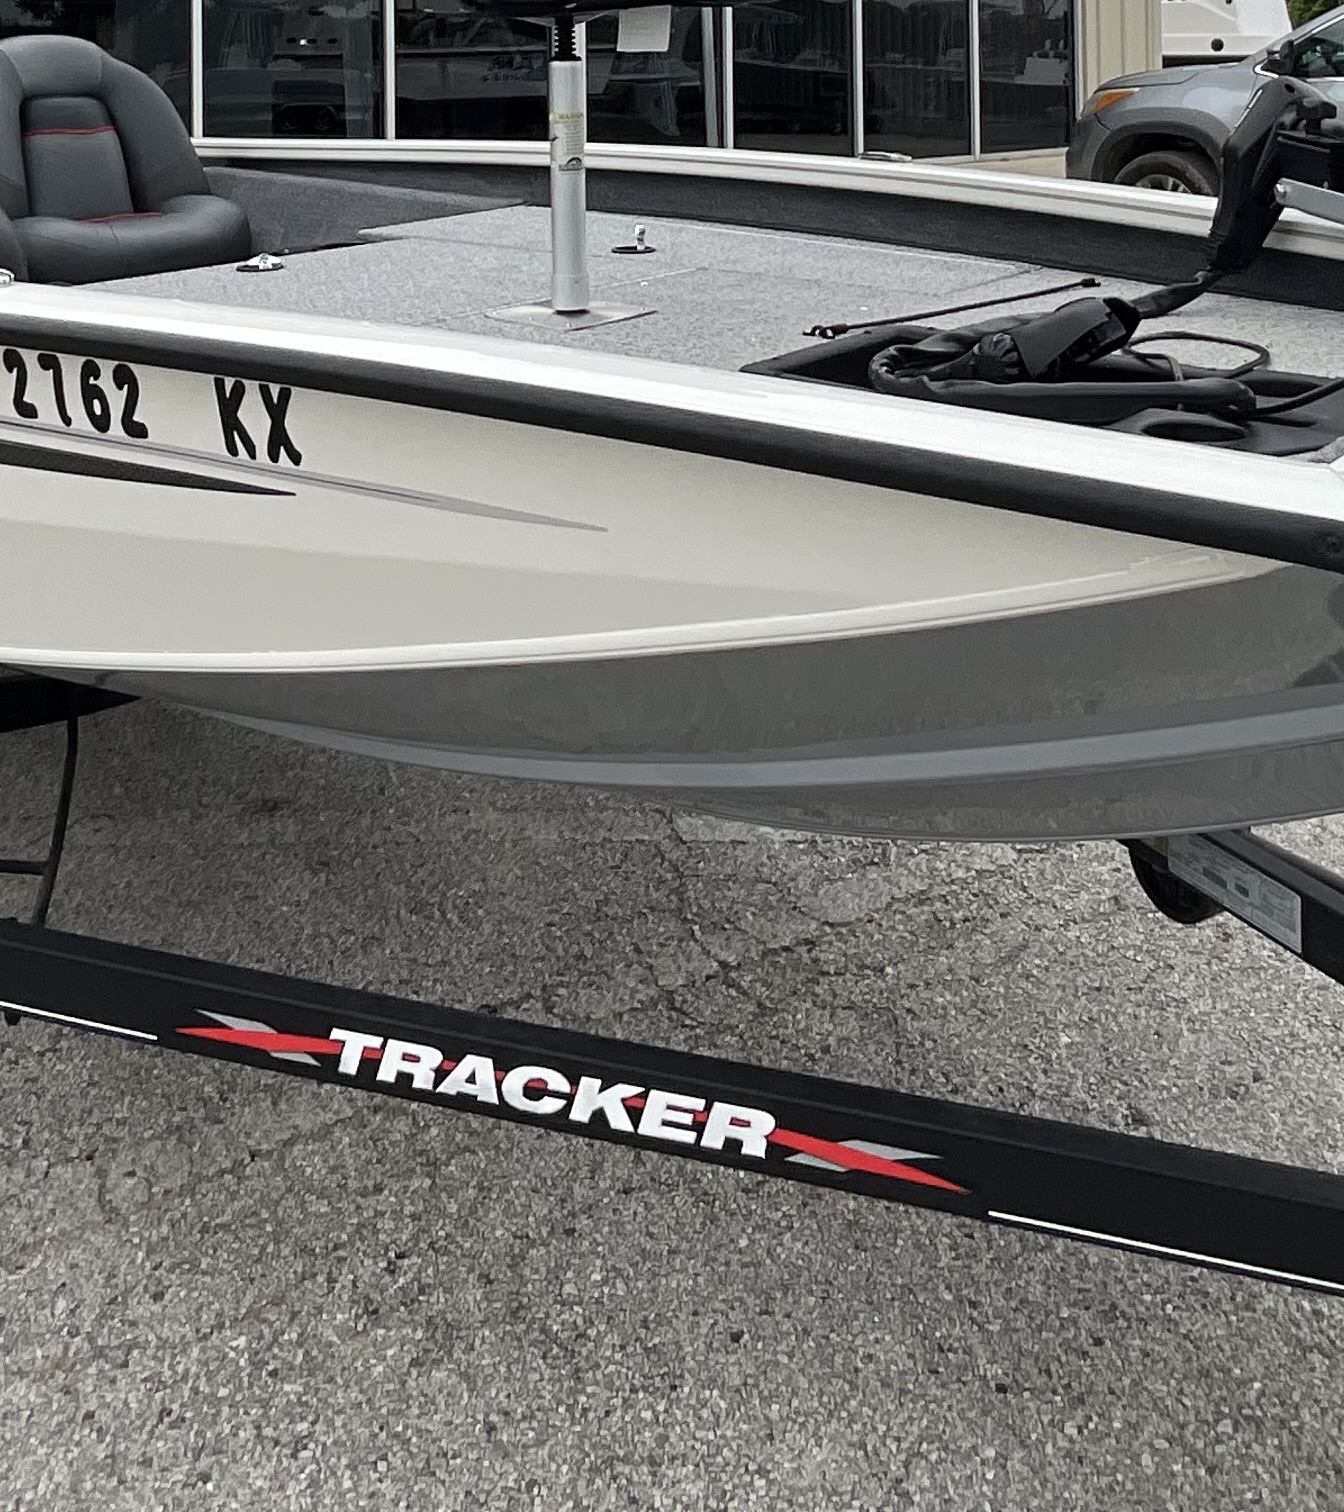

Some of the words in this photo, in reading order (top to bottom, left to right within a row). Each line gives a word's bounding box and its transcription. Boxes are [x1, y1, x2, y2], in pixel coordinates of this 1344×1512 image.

[3, 348, 149, 439] 2762
[214, 376, 303, 467] KX
[329, 1027, 776, 1159] TRACKER
